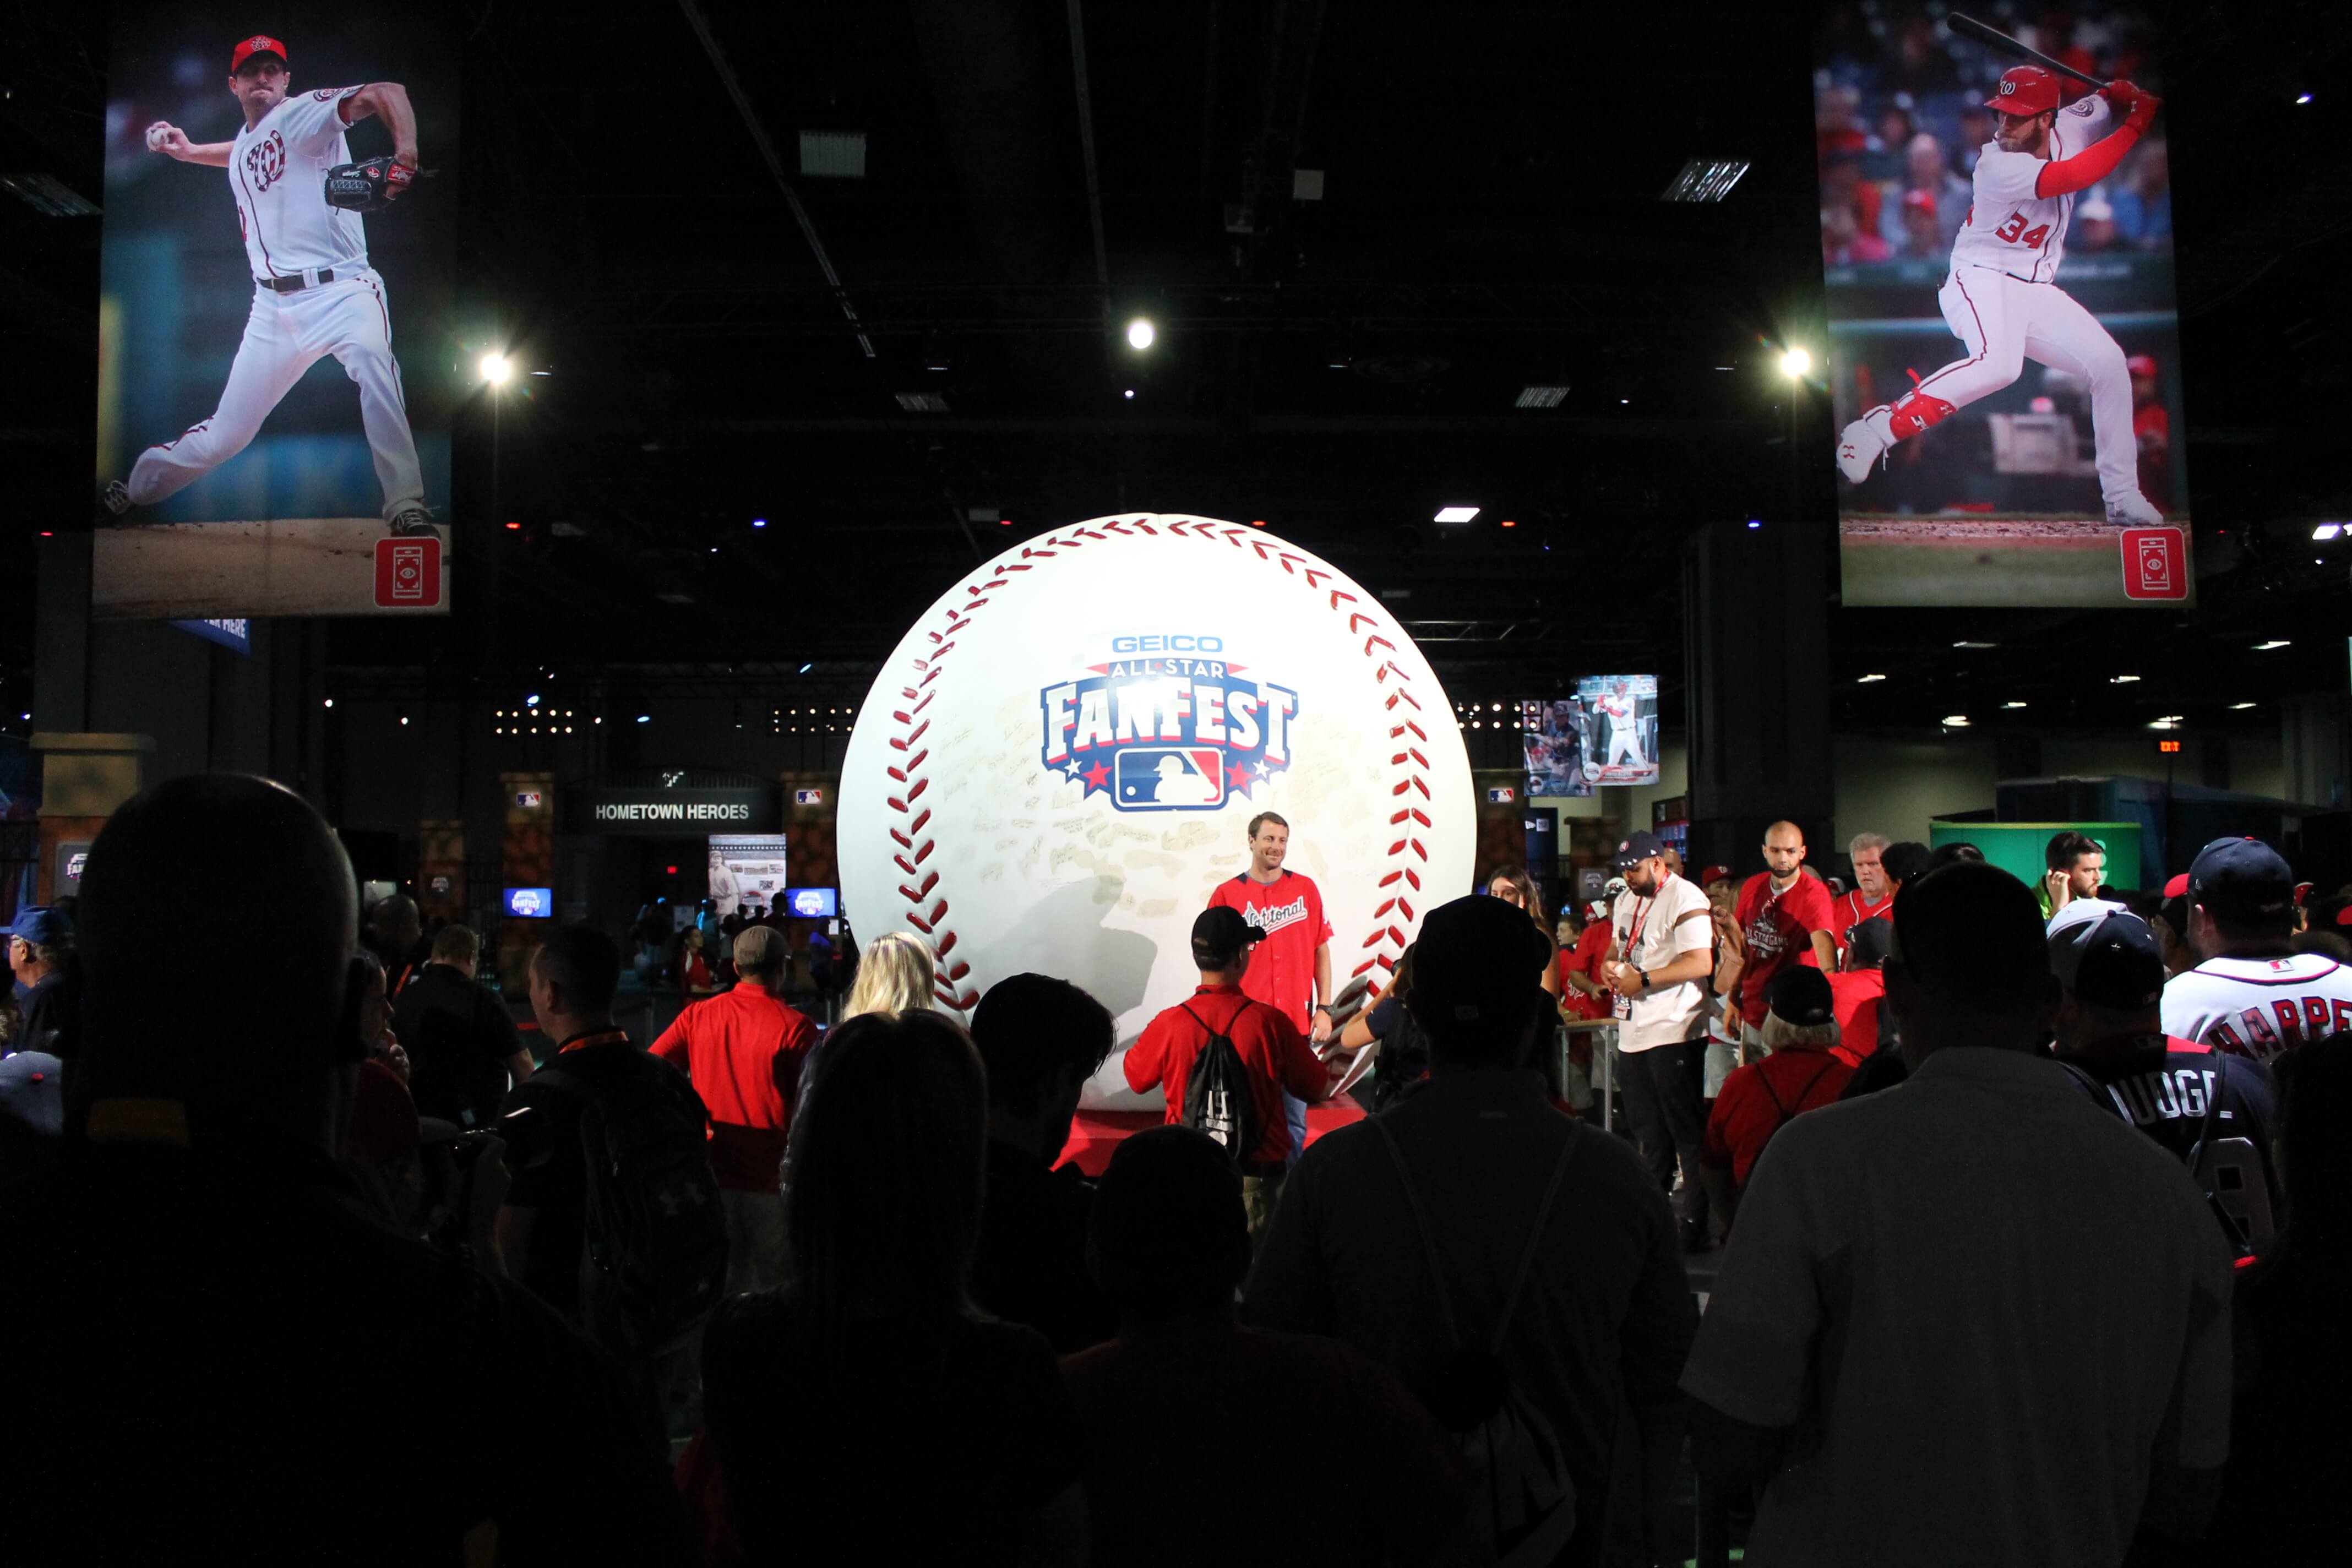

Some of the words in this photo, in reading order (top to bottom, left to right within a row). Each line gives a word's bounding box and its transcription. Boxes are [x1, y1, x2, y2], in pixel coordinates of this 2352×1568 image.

[2000, 81, 2016, 95] W
[1995, 211, 2050, 249] 34
[1112, 635, 1223, 653] GEICO
[1111, 660, 1156, 679] ALL
[1165, 659, 1224, 679] STAR
[1046, 677, 1294, 765] FANFEST
[596, 804, 683, 820] HOMETOWN
[687, 804, 749, 820] HEROES
